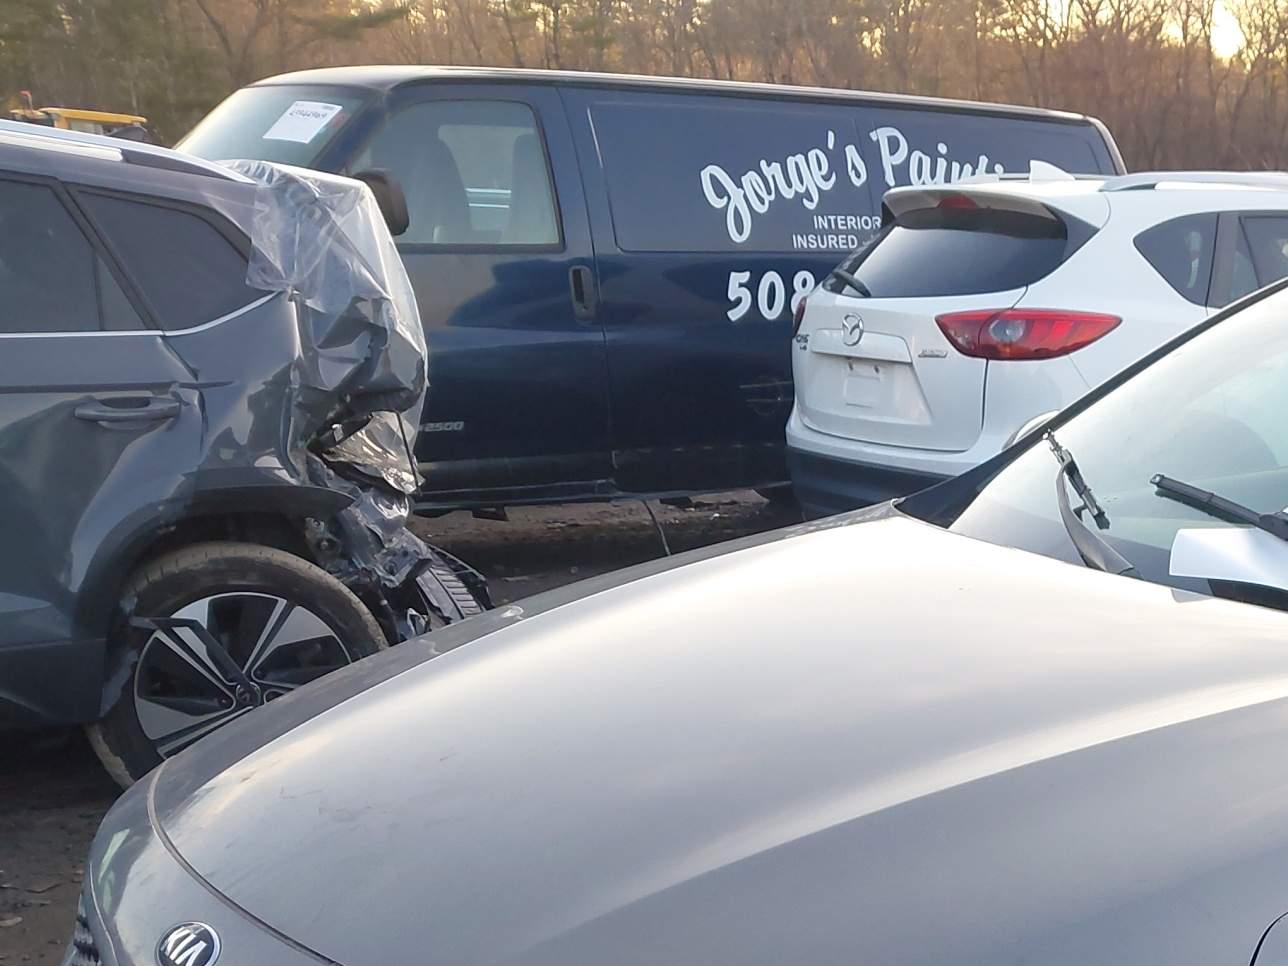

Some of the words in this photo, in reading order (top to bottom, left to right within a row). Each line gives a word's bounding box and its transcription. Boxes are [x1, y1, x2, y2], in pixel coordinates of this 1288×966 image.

[701, 130, 868, 243] Jorge's
[813, 214, 882, 231] INTERIOR
[792, 233, 859, 249] INSURED
[726, 270, 816, 323] 508
[424, 421, 465, 433] 2500
